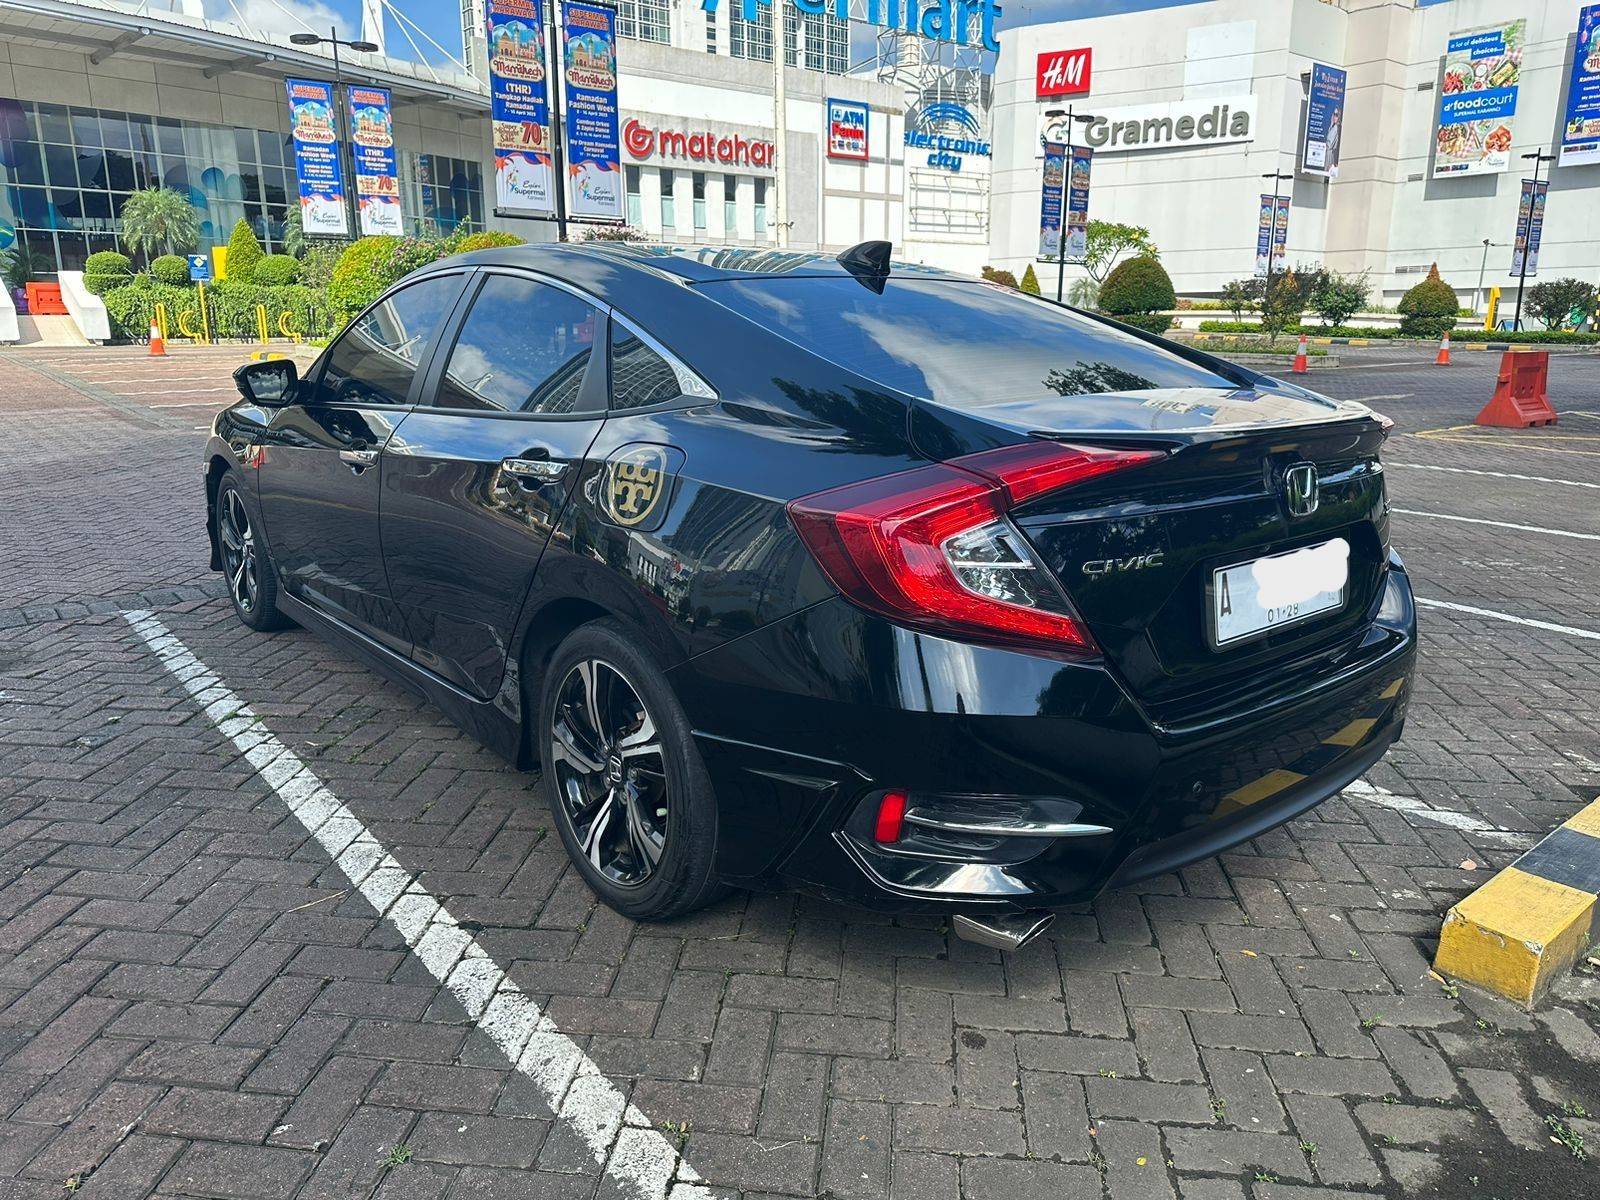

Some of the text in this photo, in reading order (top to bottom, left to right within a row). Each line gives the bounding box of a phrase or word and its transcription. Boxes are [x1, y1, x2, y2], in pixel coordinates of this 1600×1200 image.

[1470, 36, 1499, 45] delicious
[1041, 53, 1086, 89] H&M
[576, 93, 608, 104] Ramadan
[842, 110, 865, 126] ATM
[1084, 104, 1250, 147] Gramedia
[521, 121, 543, 146] 70
[904, 130, 991, 156] electronic
[927, 151, 962, 171] city
[514, 187, 547, 198] Supermal
[1081, 552, 1164, 577] CIVIC
[1219, 571, 1232, 618] A
